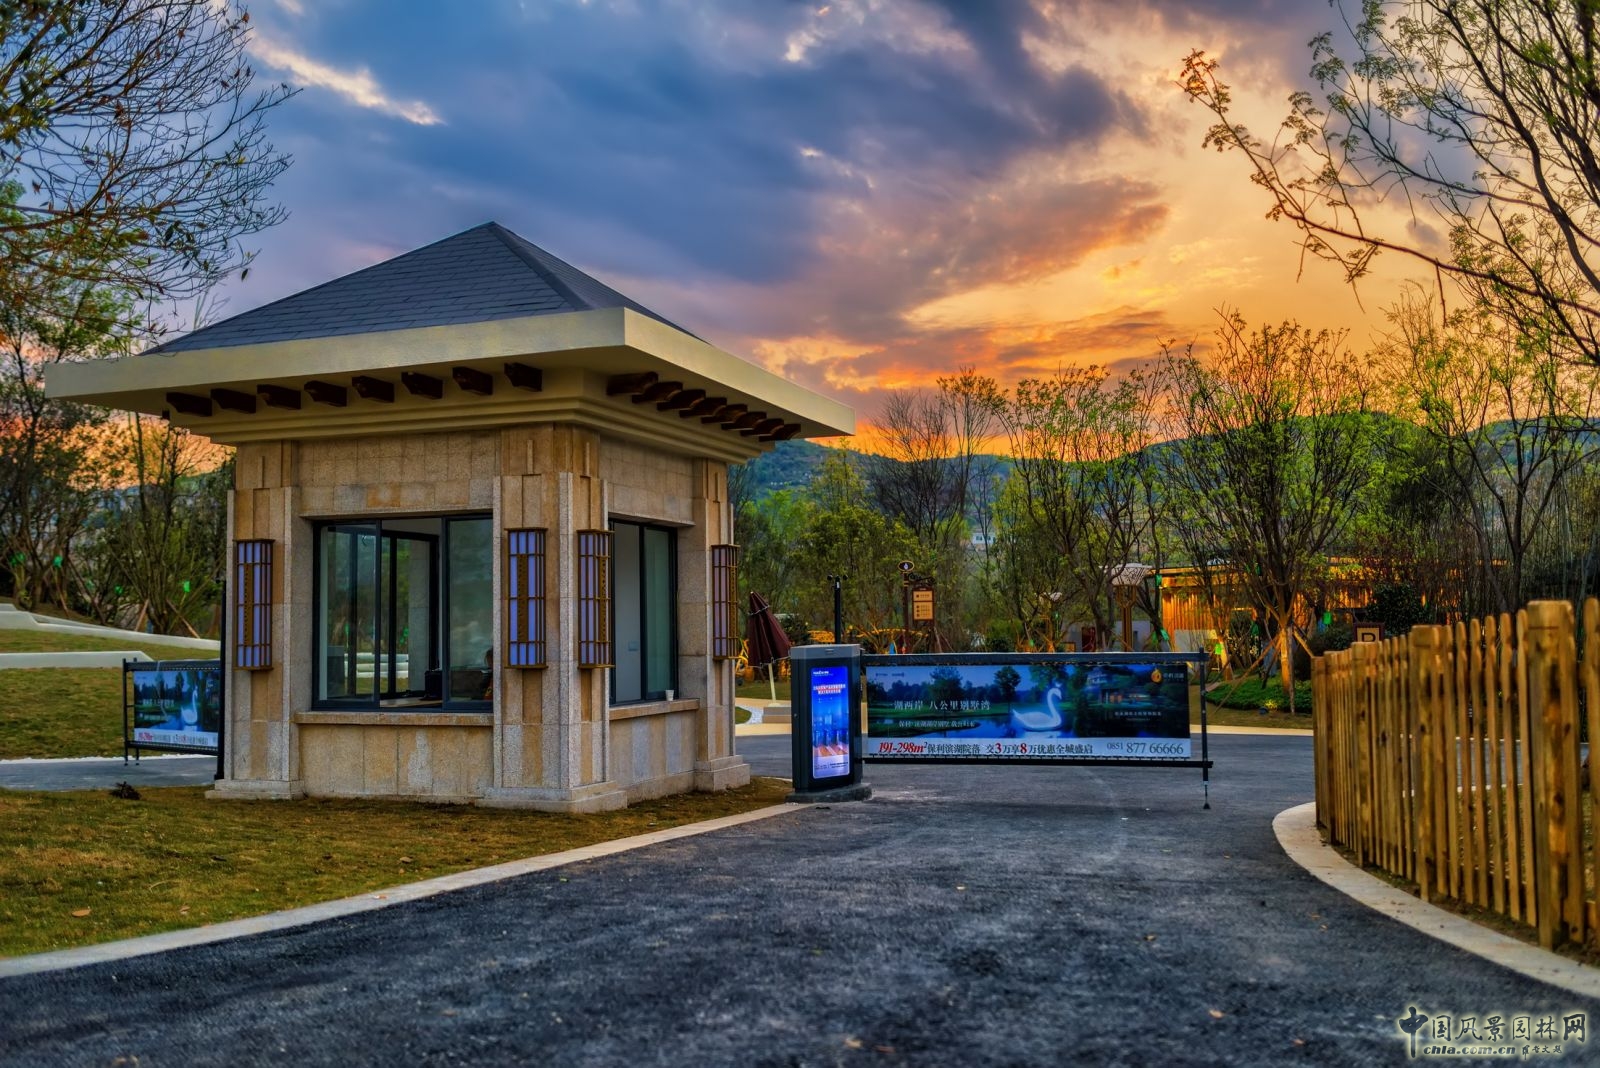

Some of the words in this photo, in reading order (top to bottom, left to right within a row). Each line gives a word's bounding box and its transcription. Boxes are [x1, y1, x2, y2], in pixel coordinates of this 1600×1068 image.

[1106, 742, 1124, 750] 0851
[1126, 742, 1147, 754] 877
[1149, 742, 1184, 755] 66666
